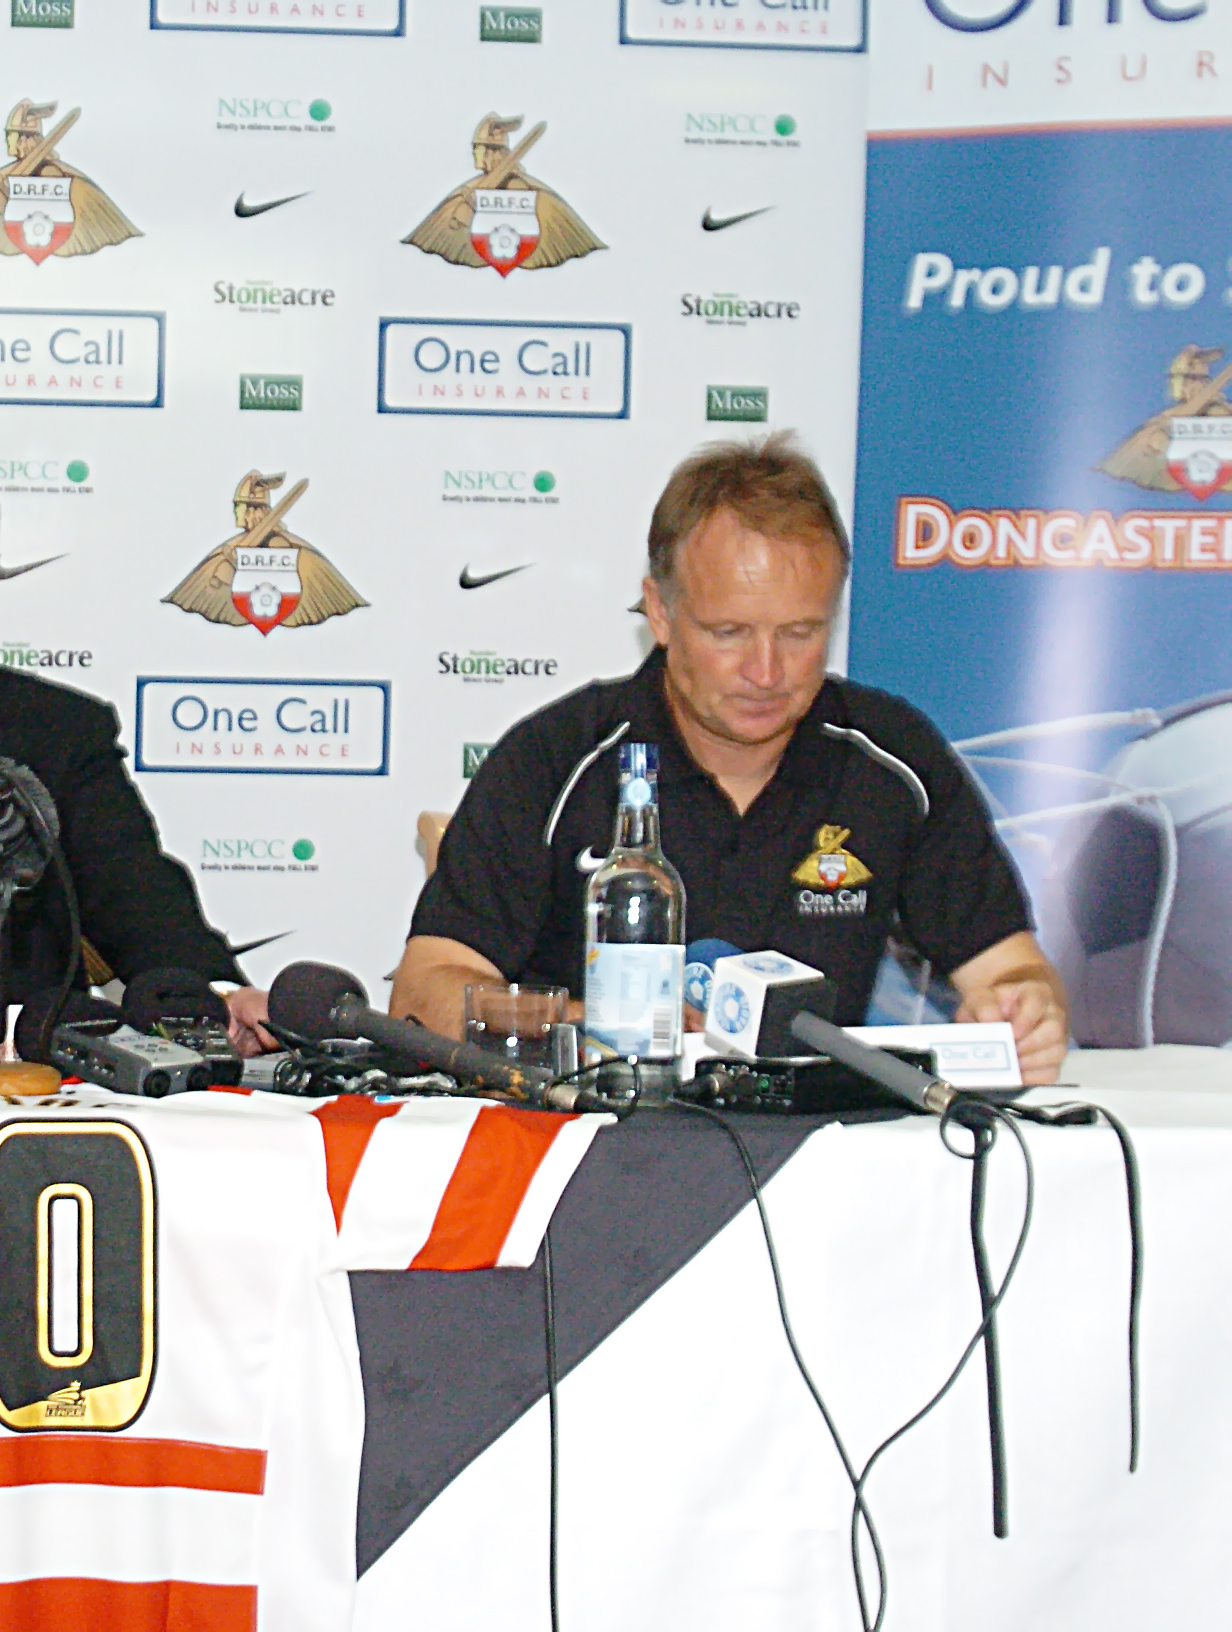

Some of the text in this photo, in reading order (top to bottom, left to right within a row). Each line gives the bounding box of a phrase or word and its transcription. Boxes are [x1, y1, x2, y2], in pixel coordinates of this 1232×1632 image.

[16, 0, 71, 17] Moss
[190, 0, 365, 18] INSURANCE
[484, 10, 539, 32] Moss
[658, 16, 830, 35] INSURANCE
[925, 49, 1219, 91] INSUR
[216, 97, 302, 119] NSPCC
[685, 112, 767, 134] NSPCC
[12, 183, 68, 197] D.R.F.C.
[907, 247, 1206, 310] Proud to
[213, 280, 336, 307] Stoneacre
[680, 293, 801, 319] Stoneacre
[48, 327, 124, 366] Call
[413, 336, 591, 378] One Call
[244, 378, 299, 399] Moss
[417, 383, 590, 401] INSURANCE
[710, 389, 765, 411] Moss
[443, 470, 526, 491] NSPCC
[240, 554, 297, 569] D.R.F.C.
[438, 651, 558, 676] Stoneacre
[171, 695, 350, 735] One Call
[175, 741, 350, 758] INSURANCE
[201, 838, 286, 859] NSPCC
[799, 889, 833, 905] One
